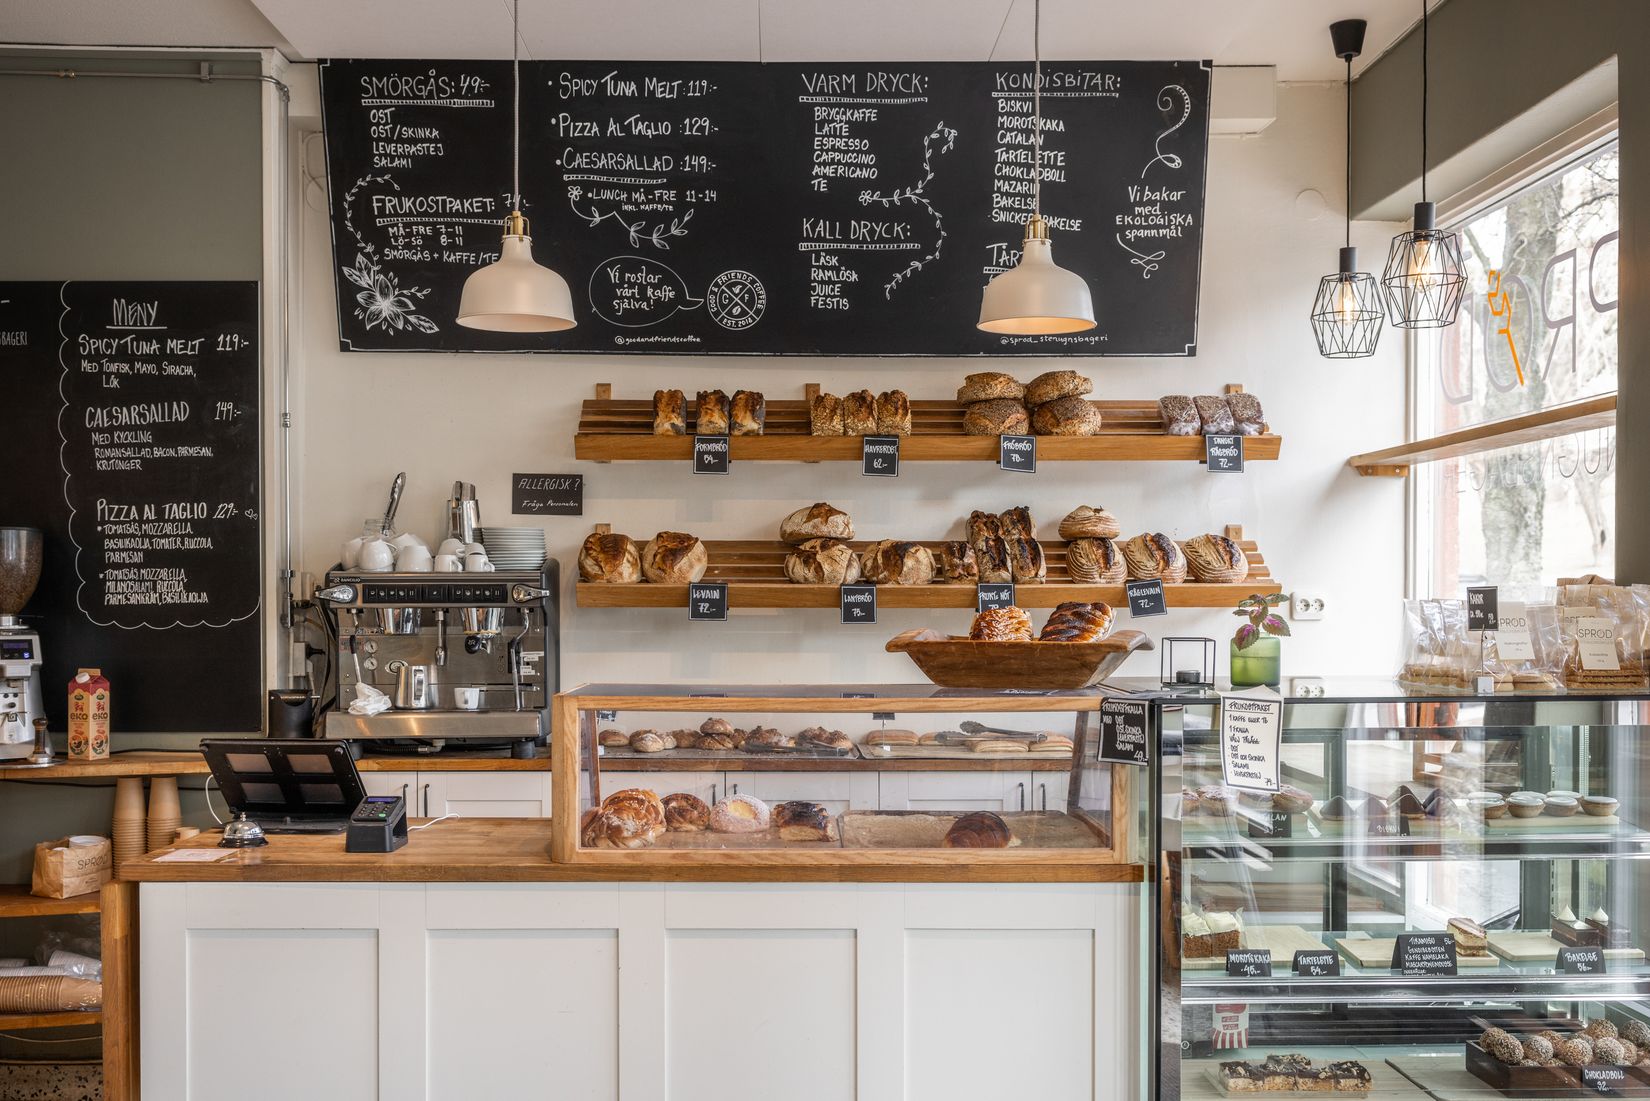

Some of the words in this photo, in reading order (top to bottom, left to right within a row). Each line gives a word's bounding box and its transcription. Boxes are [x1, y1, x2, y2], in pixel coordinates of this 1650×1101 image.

[360, 69, 455, 99] SMÖRGÅS:
[559, 72, 598, 99] SPICY
[600, 70, 638, 97] TUNA
[644, 77, 682, 98] MELT
[801, 72, 856, 94] VARM
[866, 72, 929, 94] DRYCK:
[998, 99, 1032, 113] BISKVI
[370, 107, 396, 123] OST
[814, 106, 878, 123] BRYGGKAFFE
[371, 124, 440, 140] OST/SKINKA
[559, 113, 600, 137] PIZZA
[607, 117, 626, 137] AL
[624, 114, 671, 139] TAGLIO
[815, 122, 849, 136] LATTE
[373, 141, 444, 156] LEVERPASTEJ
[814, 137, 869, 150] ESPRESSO
[373, 156, 412, 169] SALAMI
[563, 147, 674, 171] CAESARSALLAD
[813, 151, 876, 165] CAPPUCCINO
[994, 147, 1065, 166] TARTELETTE
[812, 164, 878, 179] AMERICANO
[994, 163, 1066, 182] CHOKLADBOLL
[811, 178, 828, 191] TE
[592, 189, 627, 202] LUNCH
[686, 190, 717, 202] 11-14
[1128, 185, 1141, 202] Vi
[1143, 186, 1187, 201] bakar
[372, 195, 496, 216] FRUKOSTPAKET:
[1135, 204, 1161, 215] med
[388, 223, 433, 235] MÅ-FRE
[436, 225, 463, 235] 7-11
[802, 217, 842, 239] KALL
[850, 220, 911, 242] DRYCK:
[1125, 225, 1183, 242] spannmål
[391, 236, 423, 246] LÖ-SÖ
[440, 236, 463, 246] 8-11
[384, 246, 431, 261] SMÖRGÅS
[812, 252, 839, 266] LÄSK
[607, 264, 621, 284] Vi
[625, 266, 662, 284] rostar
[811, 267, 859, 282] RAMLÖSA
[616, 283, 639, 299] vårt
[647, 285, 676, 300] kaffe
[717, 272, 753, 285] FRIENDS
[753, 282, 765, 310] COFFEE
[811, 283, 842, 296] JUICE
[613, 297, 654, 315] själva!
[722, 293, 729, 304] G
[744, 294, 749, 303] F
[810, 296, 850, 310] FESTIS
[113, 298, 158, 326] MENY
[722, 318, 737, 328] EST.
[78, 333, 119, 355] SPICY
[119, 334, 160, 355] TUNA
[167, 338, 205, 355] MELT
[216, 334, 250, 351] 119:-
[81, 359, 99, 373] MED
[100, 358, 133, 376] TONFISK,
[134, 361, 159, 376] MAYO,
[162, 361, 197, 378] SIRACHA,
[102, 375, 120, 389] LÖK
[85, 401, 190, 429] CAESARSALLAD
[214, 401, 242, 421] 149:-
[91, 432, 110, 446] MED
[114, 431, 152, 444] KYCKLING
[96, 459, 143, 471] KRUTONGER
[518, 478, 572, 490] ALLERGISK
[97, 498, 139, 521] PIZZA
[143, 504, 158, 521] AL
[162, 502, 207, 520] TAGLIO
[105, 551, 144, 563] PARMESAN
[692, 588, 720, 599] LEVAIN
